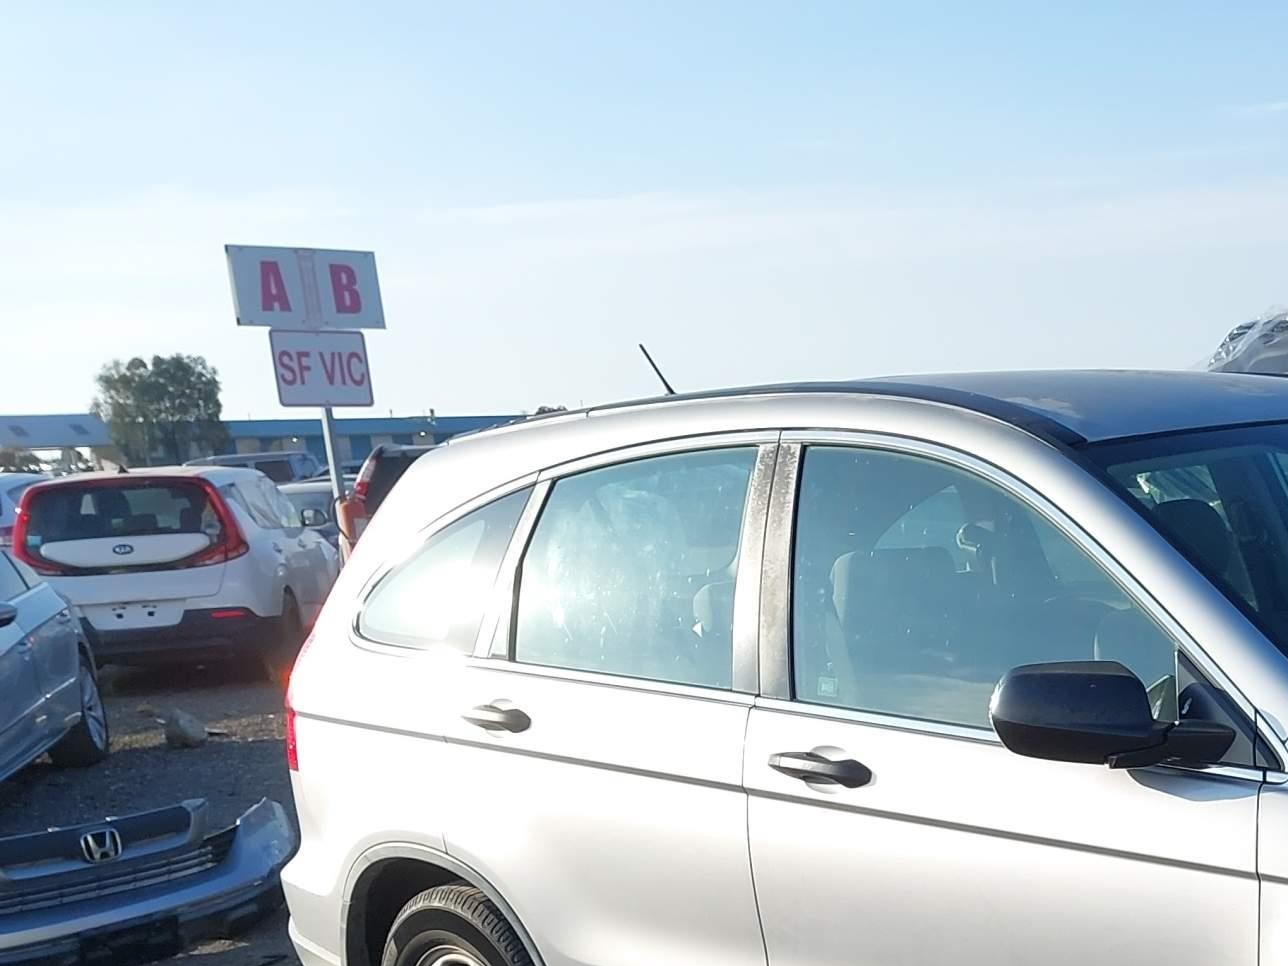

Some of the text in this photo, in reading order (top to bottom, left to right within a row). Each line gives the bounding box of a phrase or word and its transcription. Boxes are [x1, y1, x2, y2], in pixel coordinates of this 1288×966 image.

[260, 261, 362, 314] A B
[278, 350, 365, 386] SF VIC
